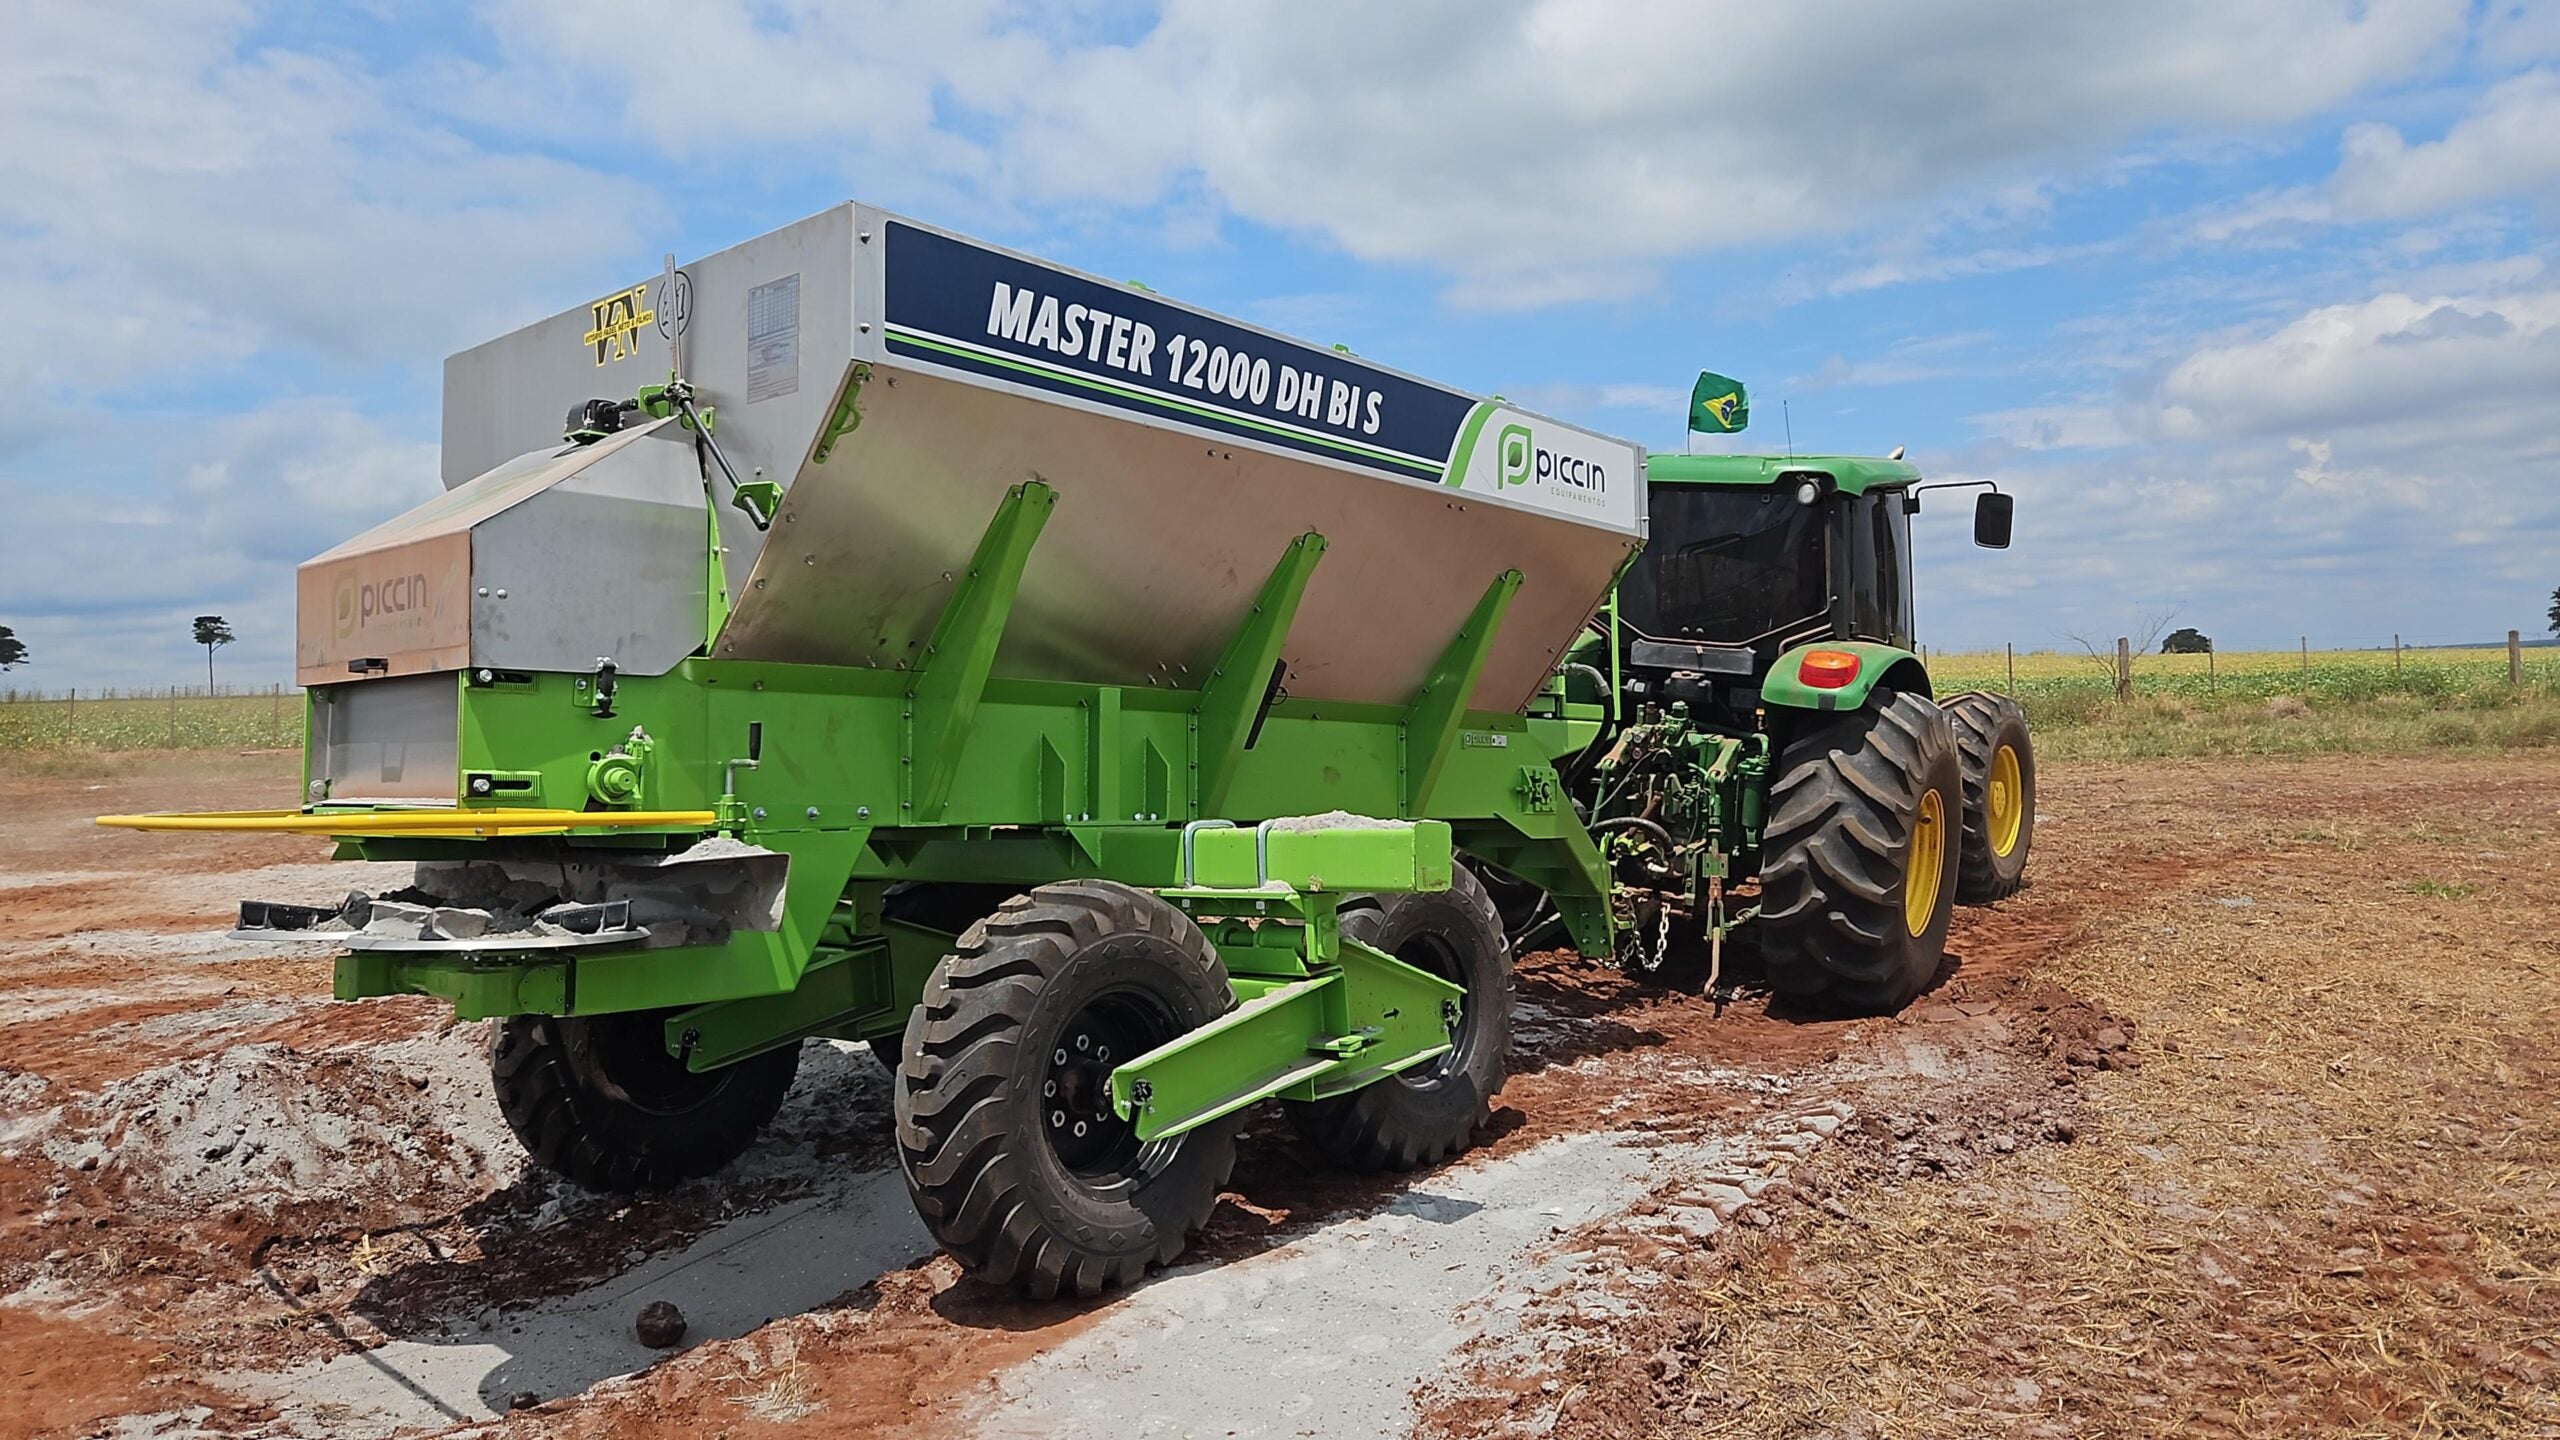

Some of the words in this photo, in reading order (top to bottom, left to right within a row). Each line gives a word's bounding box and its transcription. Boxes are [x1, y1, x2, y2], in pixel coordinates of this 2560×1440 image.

[987, 281, 1156, 376] MASTER
[1166, 334, 1270, 405] 12000
[1275, 365, 1324, 420] DH
[1327, 380, 1361, 430] BI
[1362, 391, 1384, 435] S
[1551, 487, 1606, 508] EQUIPAMENTOS
